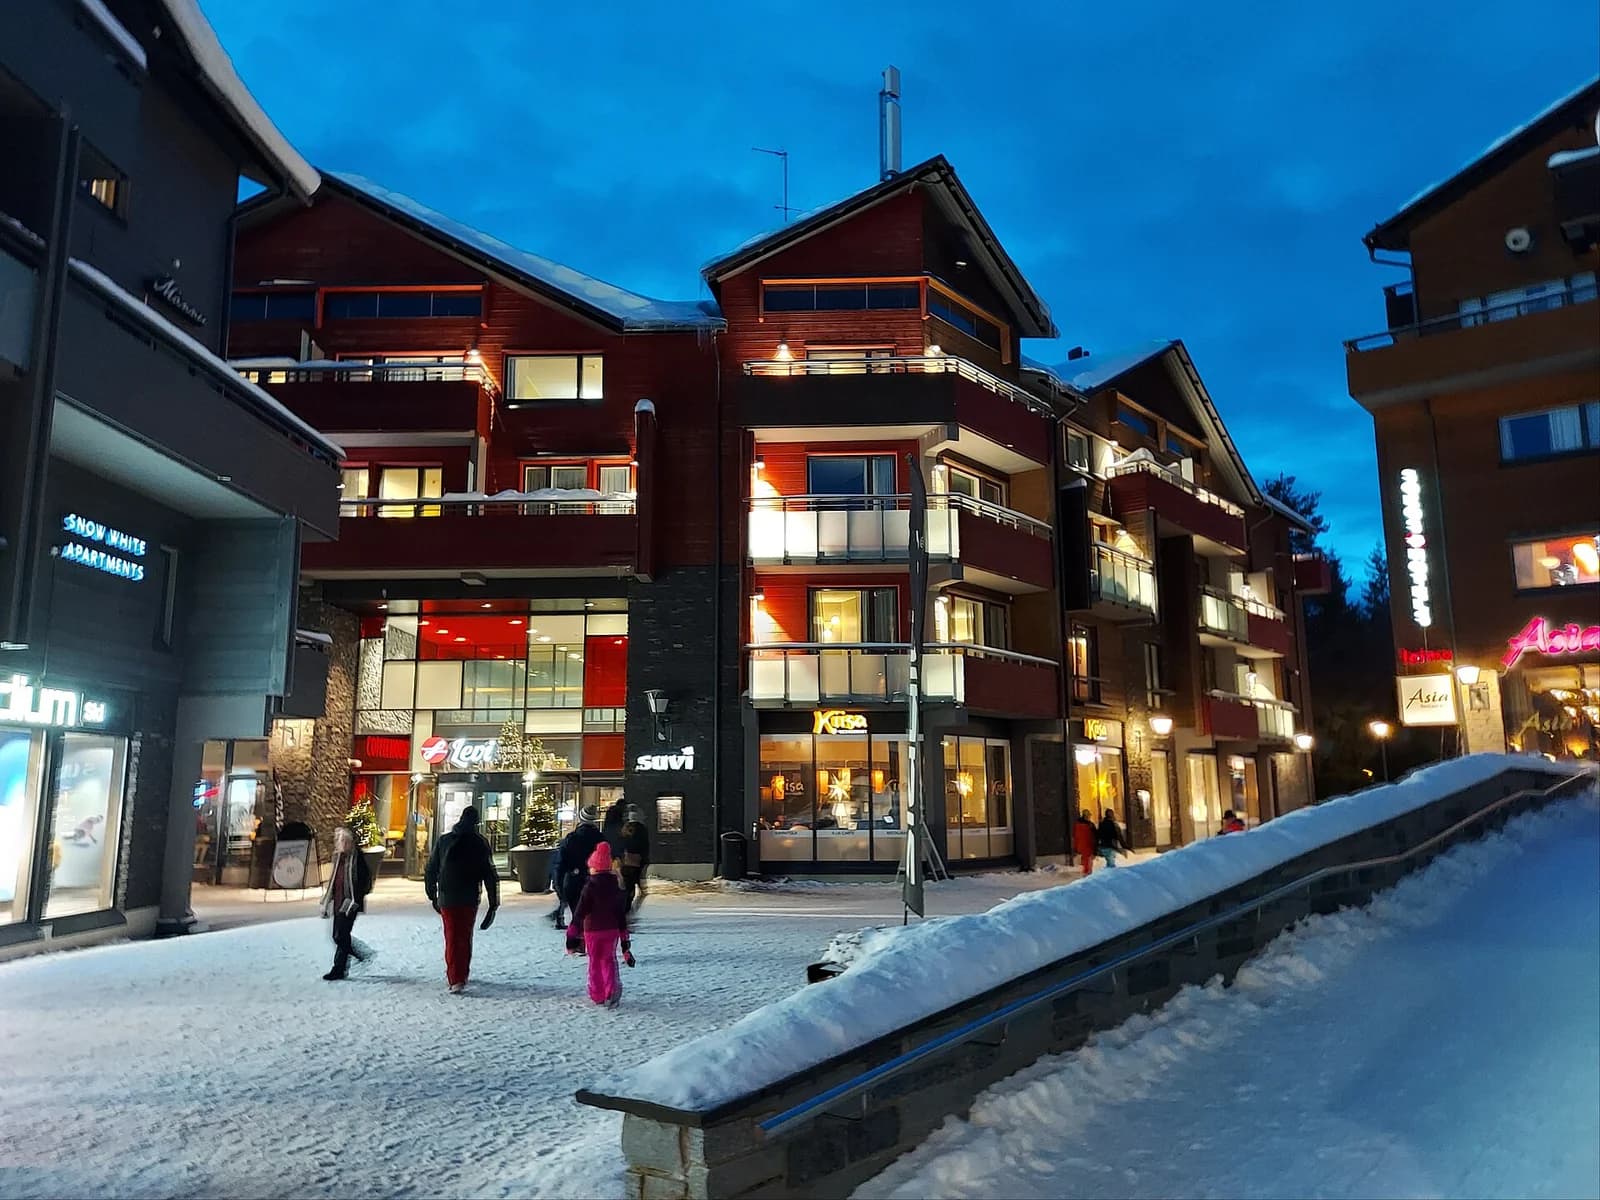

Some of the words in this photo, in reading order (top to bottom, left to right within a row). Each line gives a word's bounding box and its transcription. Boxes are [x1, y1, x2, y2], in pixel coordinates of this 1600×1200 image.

[63, 513, 106, 541] SNOW
[105, 528, 146, 556] WHITE
[61, 542, 144, 580] APARTMENTS
[1501, 616, 1600, 668] Asia
[1406, 687, 1449, 711] Asia
[449, 738, 500, 767] Levi
[634, 745, 695, 772] suvi
